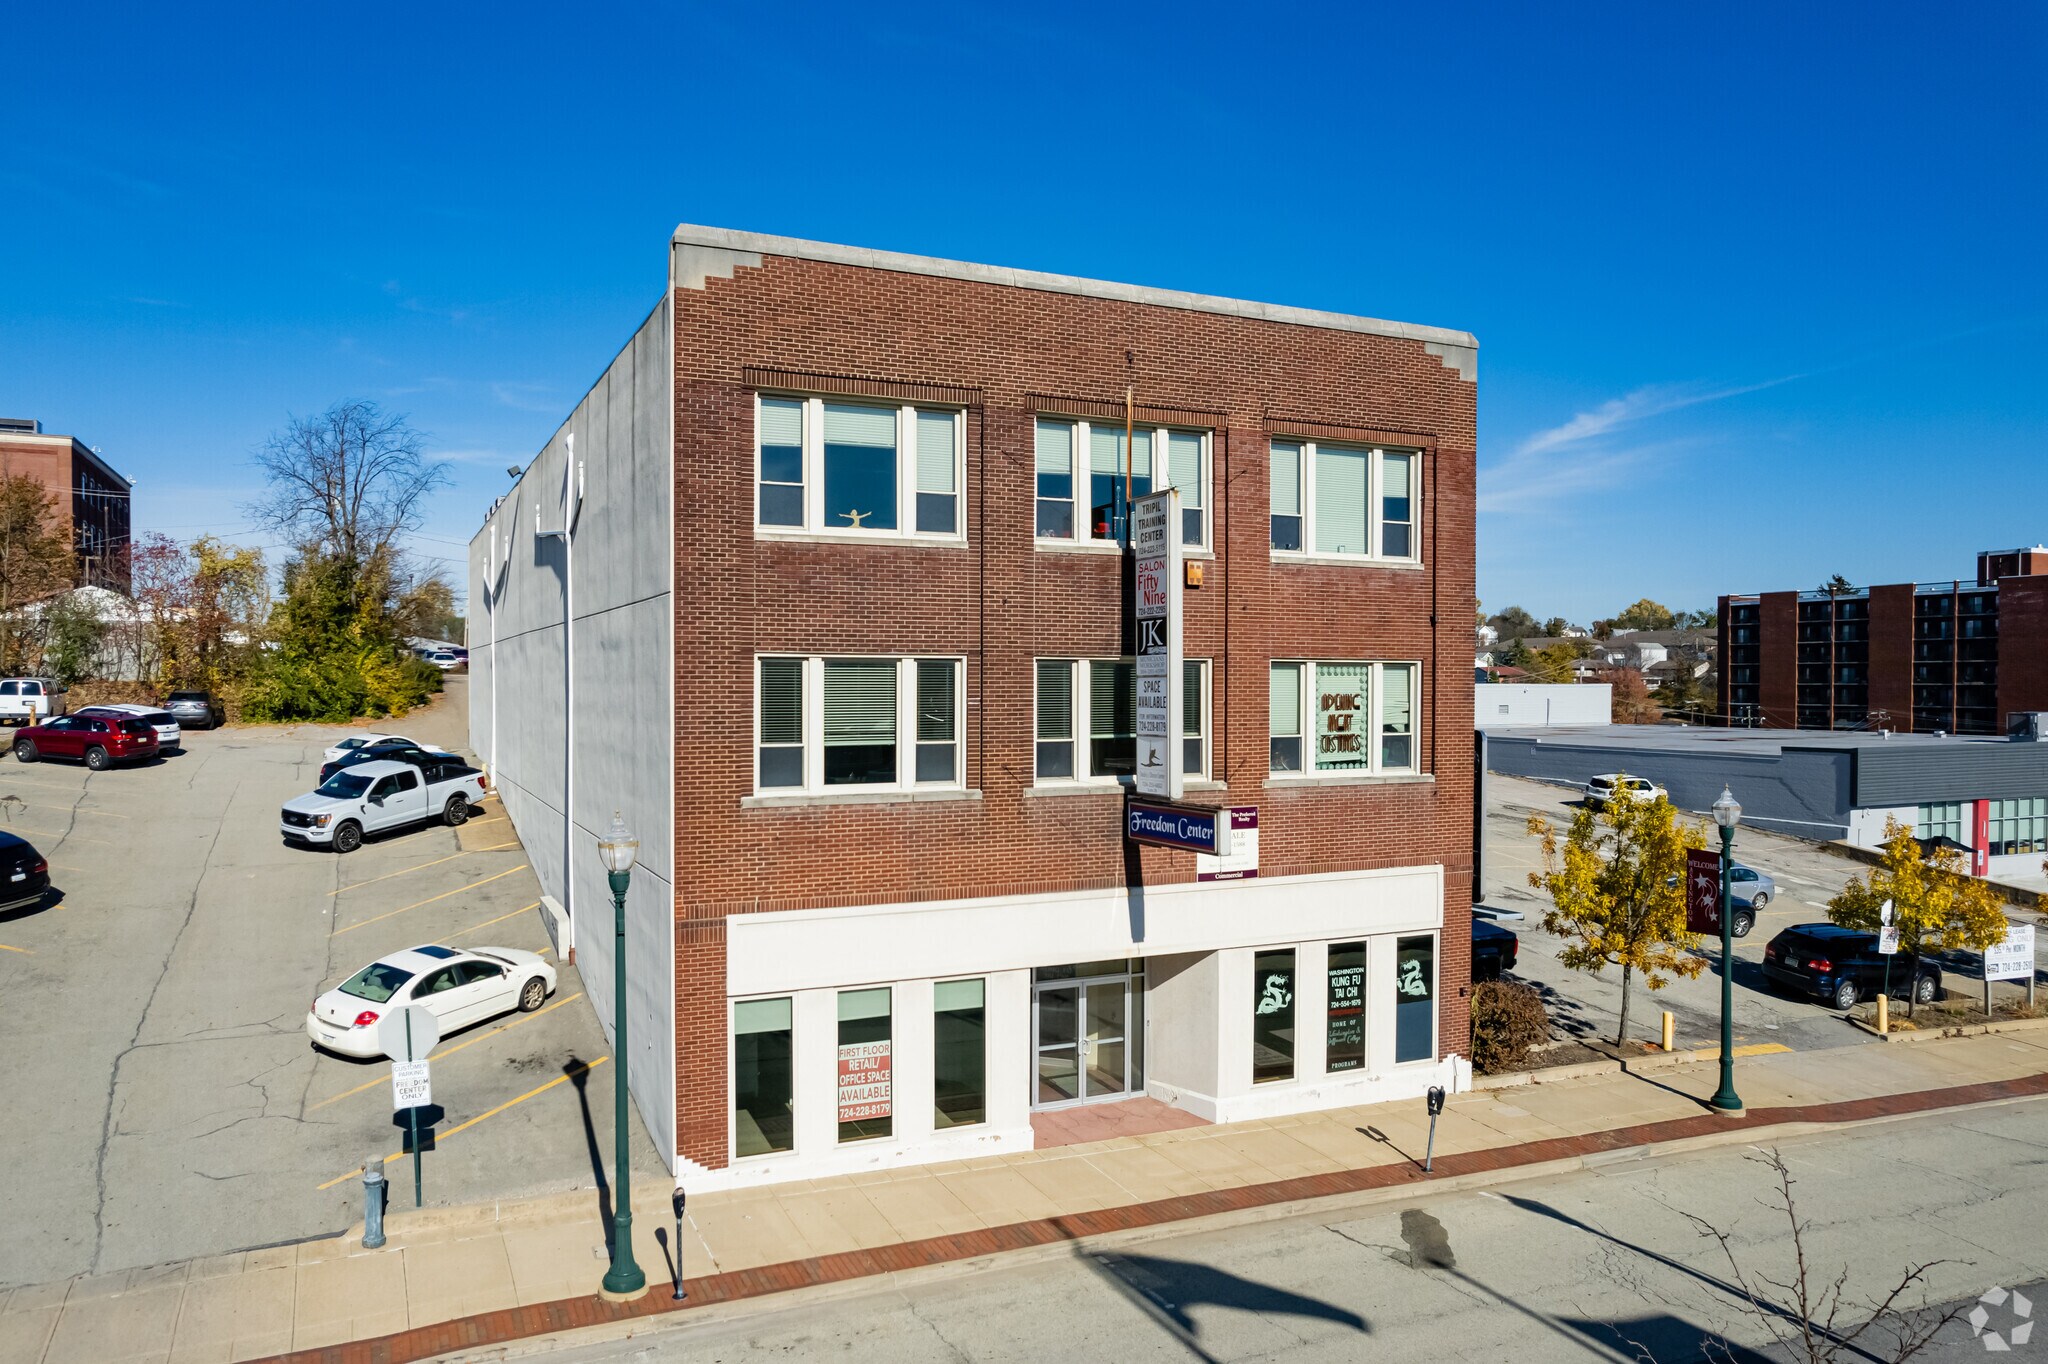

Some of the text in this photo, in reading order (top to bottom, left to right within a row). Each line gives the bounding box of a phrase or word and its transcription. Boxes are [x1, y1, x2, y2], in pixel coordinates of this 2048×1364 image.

[1142, 501, 1161, 515] TRIPIL
[1138, 514, 1166, 530] TRAINING
[1140, 529, 1164, 544] CENTER
[1138, 560, 1165, 573] SALON
[1138, 573, 1159, 592] Fifty
[1143, 590, 1166, 606] Nine
[1140, 619, 1163, 653] JK
[1143, 680, 1161, 693] SPACE
[1138, 695, 1167, 709] AVAILABLE
[1131, 811, 1213, 839] Freedom Center
[1687, 860, 1719, 871] WELCOME
[1214, 871, 1243, 880] Commercial
[1328, 967, 1364, 976] WASHINGTON
[1331, 974, 1361, 987] KUNG FU
[1335, 987, 1358, 998] TAI CHI
[839, 1044, 890, 1058] FIRST FLOOR
[394, 1063, 427, 1072] CUSTOMER
[849, 1056, 880, 1071] RETAIL/
[1331, 1060, 1357, 1069] PROGRAMS
[398, 1069, 424, 1077] PARKING
[840, 1070, 890, 1085] OFFICE SPACE
[395, 1078, 429, 1088] FREDOM
[399, 1085, 427, 1095] CENTER
[401, 1092, 423, 1100] ONLY
[839, 1085, 890, 1102] AVAILABLE
[839, 1103, 890, 1118] 724-228-8179
